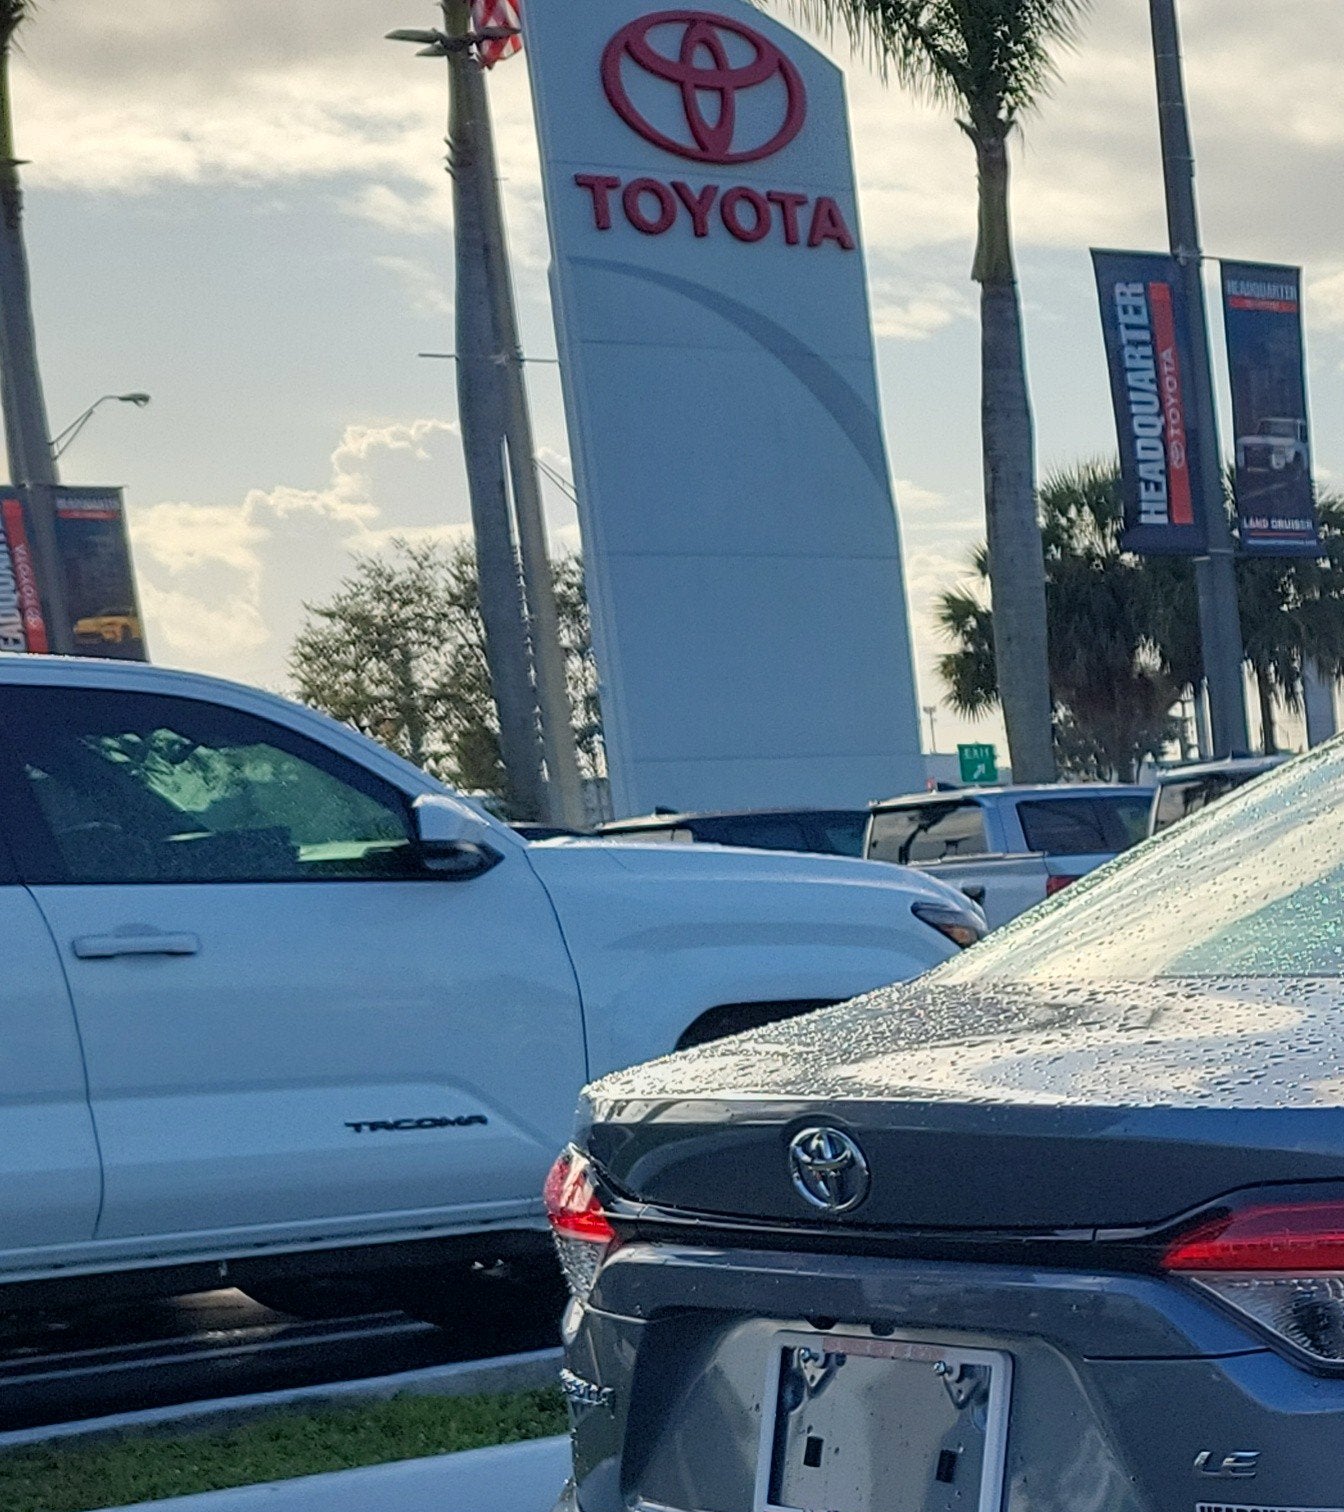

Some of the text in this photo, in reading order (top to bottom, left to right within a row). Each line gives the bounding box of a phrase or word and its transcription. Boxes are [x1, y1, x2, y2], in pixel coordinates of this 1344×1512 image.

[574, 173, 855, 250] TOYOTA
[1114, 282, 1170, 525] HEADQUARTER
[1159, 348, 1183, 438] TOYOTA
[344, 1114, 489, 1133] TACOMA
[1194, 1451, 1261, 1477] LE
